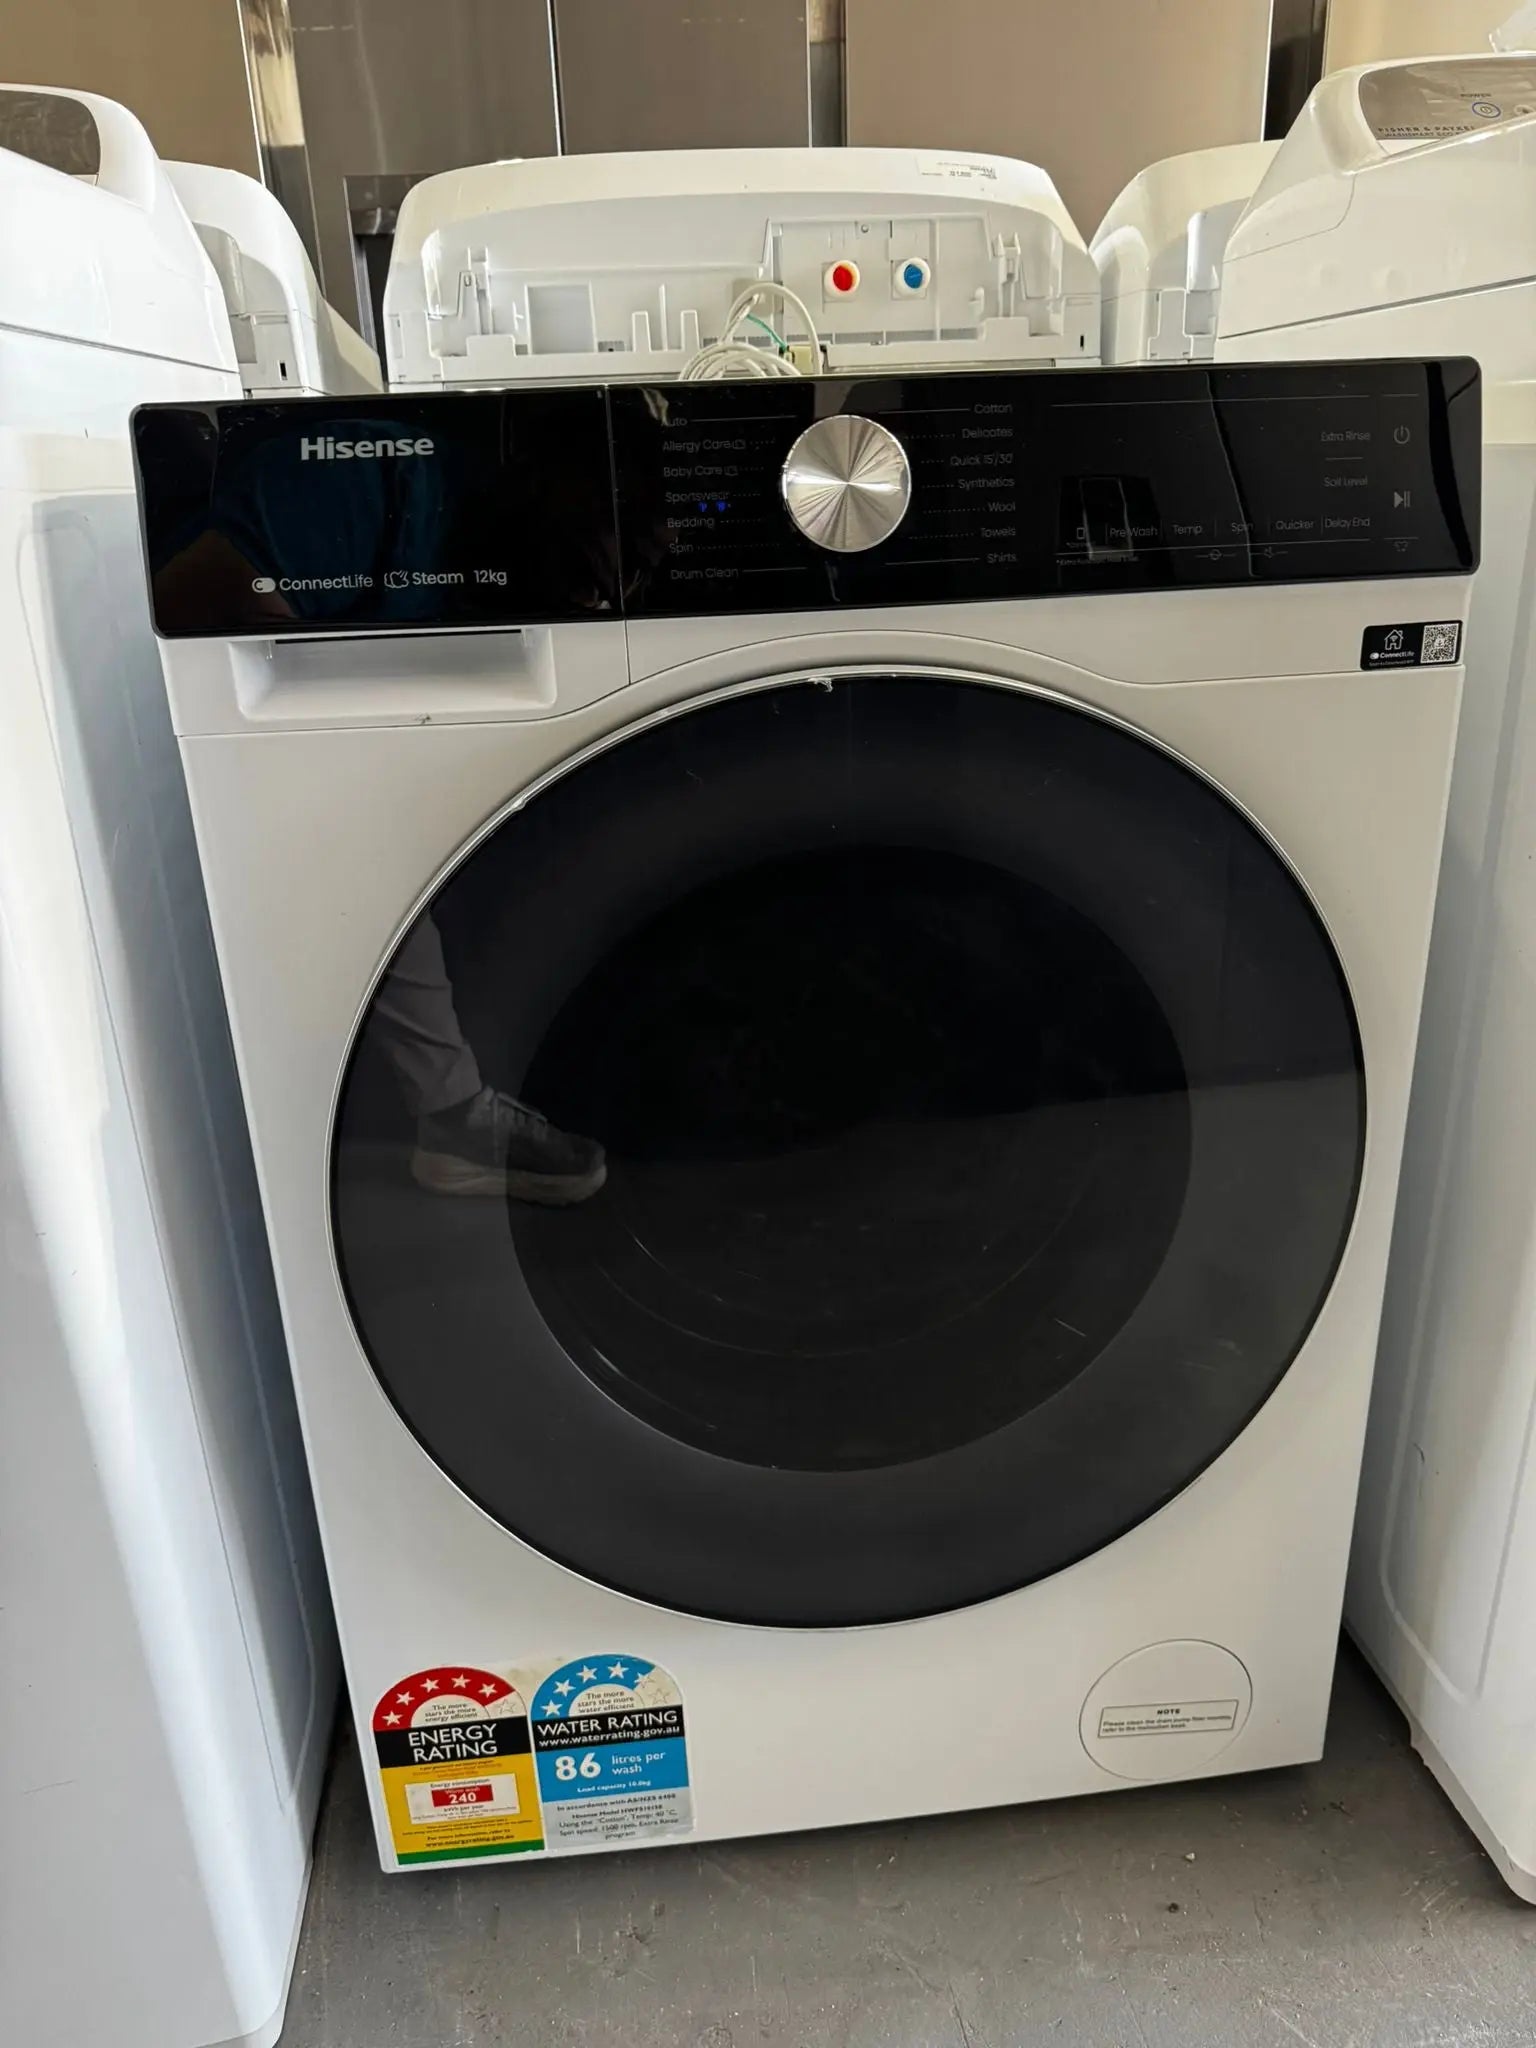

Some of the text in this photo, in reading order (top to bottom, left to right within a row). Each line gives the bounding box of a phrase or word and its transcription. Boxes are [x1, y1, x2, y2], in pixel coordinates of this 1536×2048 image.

[974, 403, 1013, 414] Cotton
[962, 427, 1014, 439] Delicates
[1345, 430, 1371, 441] Rinse
[300, 436, 435, 461] Hisense
[663, 439, 731, 454] Allergy Care
[950, 454, 981, 467] Quick
[663, 465, 723, 479] Baby Care
[958, 476, 1016, 491] Synthetics
[665, 491, 731, 504] Sportswear
[987, 501, 1016, 512] Wool
[666, 517, 715, 530] Bedding
[1172, 523, 1203, 536] Temp
[1275, 518, 1315, 531] Quicker
[1324, 516, 1370, 531] Delay End
[980, 526, 1017, 538] Towels
[669, 543, 694, 557] Spin
[987, 552, 1017, 564] Shirts
[670, 567, 739, 580] Drum Clean
[279, 569, 508, 592] ConnectLife Steam 12kg
[1380, 650, 1415, 659] ConnectLife
[586, 1690, 625, 1700] The more
[432, 1704, 447, 1712] The
[577, 1700, 597, 1708] stars
[613, 1696, 635, 1704] more
[425, 1710, 442, 1718] stars
[444, 1708, 455, 1716] the
[579, 1703, 635, 1714] water efficient
[425, 1711, 478, 1723] energy efficient
[537, 1710, 678, 1737] WATER RATING
[408, 1723, 498, 1747] ENERGY
[539, 1725, 680, 1748] www.waterrating.gov.au
[413, 1740, 498, 1763] RATING
[611, 1751, 666, 1766] litres per
[555, 1752, 602, 1781] 86
[611, 1764, 642, 1776] wash
[430, 1778, 490, 1790] Energy consumption
[577, 1785, 596, 1793] Load
[597, 1782, 627, 1792] capacity
[448, 1792, 477, 1804] 240
[566, 1801, 608, 1811] accordance
[609, 1798, 626, 1806] with
[626, 1795, 656, 1804] AS/NZS
[460, 1804, 470, 1812] per
[471, 1803, 484, 1811] year
[599, 1808, 620, 1817] Model
[559, 1820, 579, 1830] Using
[581, 1818, 593, 1826] the
[560, 1829, 575, 1838] Spin
[639, 1818, 658, 1828] Extra
[659, 1816, 679, 1825] Rinse
[605, 1830, 636, 1840] program
